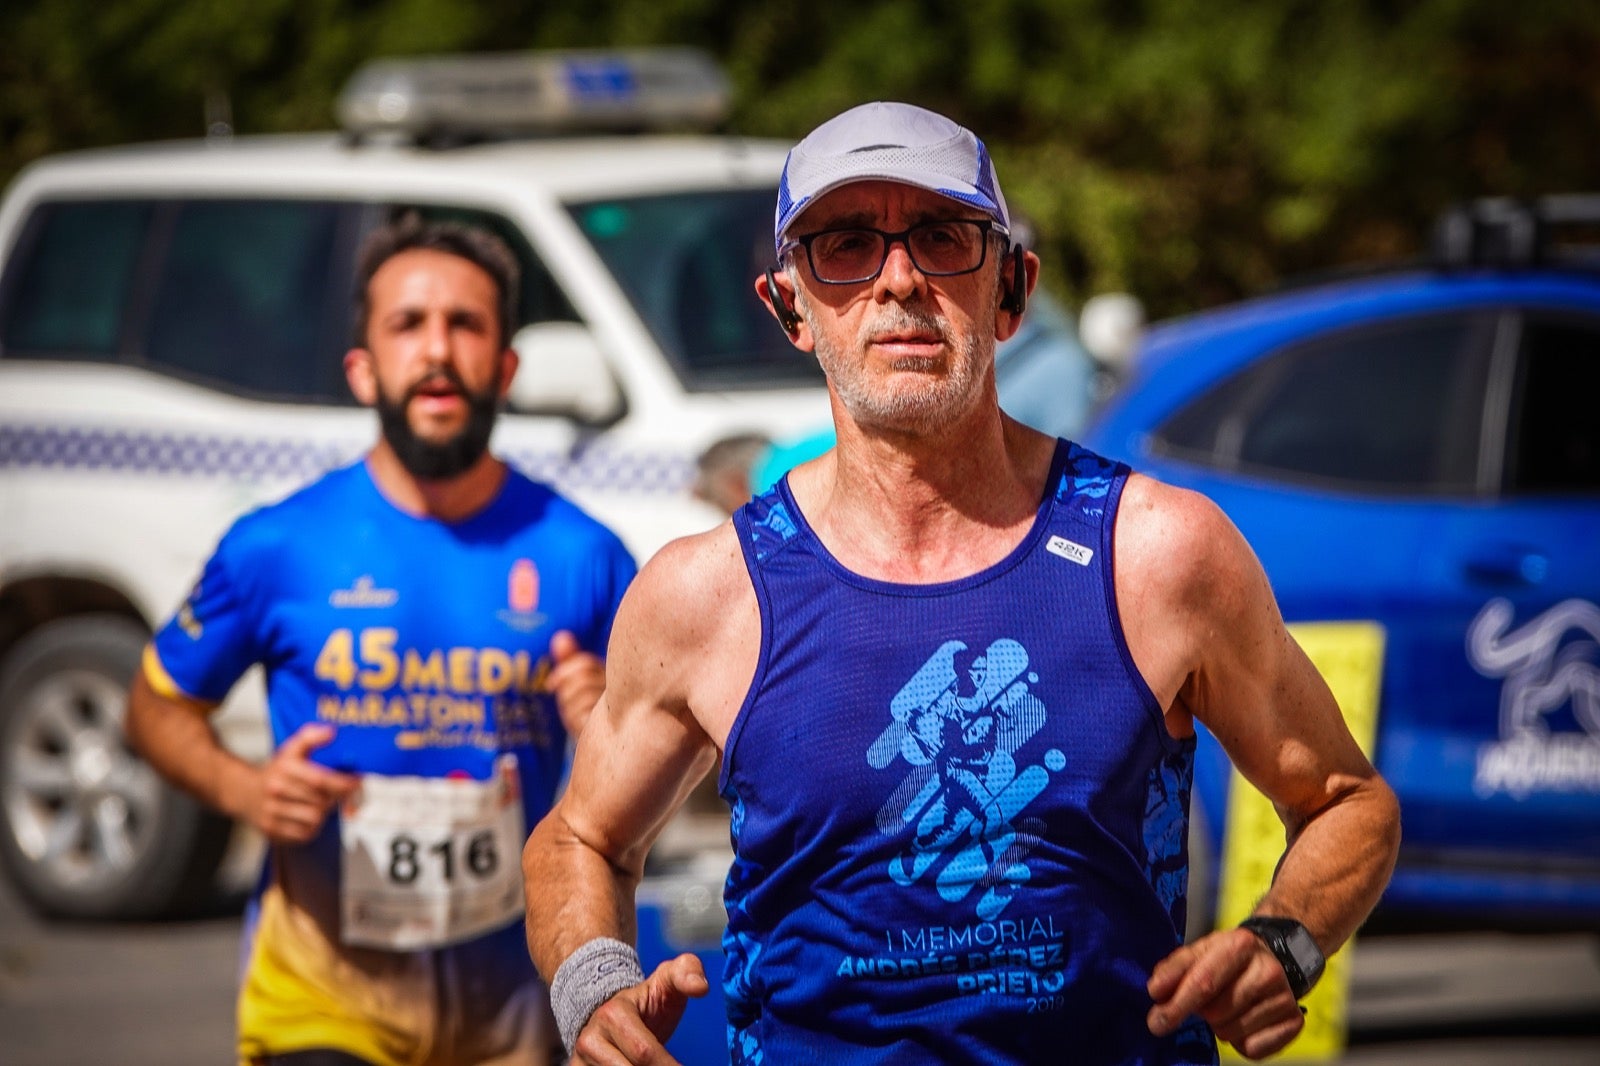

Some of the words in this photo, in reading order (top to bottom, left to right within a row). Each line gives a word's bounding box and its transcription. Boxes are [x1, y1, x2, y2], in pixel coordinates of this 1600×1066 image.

[315, 627, 399, 690] 45
[389, 830, 498, 885] 816
[901, 915, 1064, 952] MEMORIAL
[836, 951, 958, 977] ANDRÉS
[967, 943, 1064, 970] PÉREZ
[957, 970, 1065, 994] PRIETO
